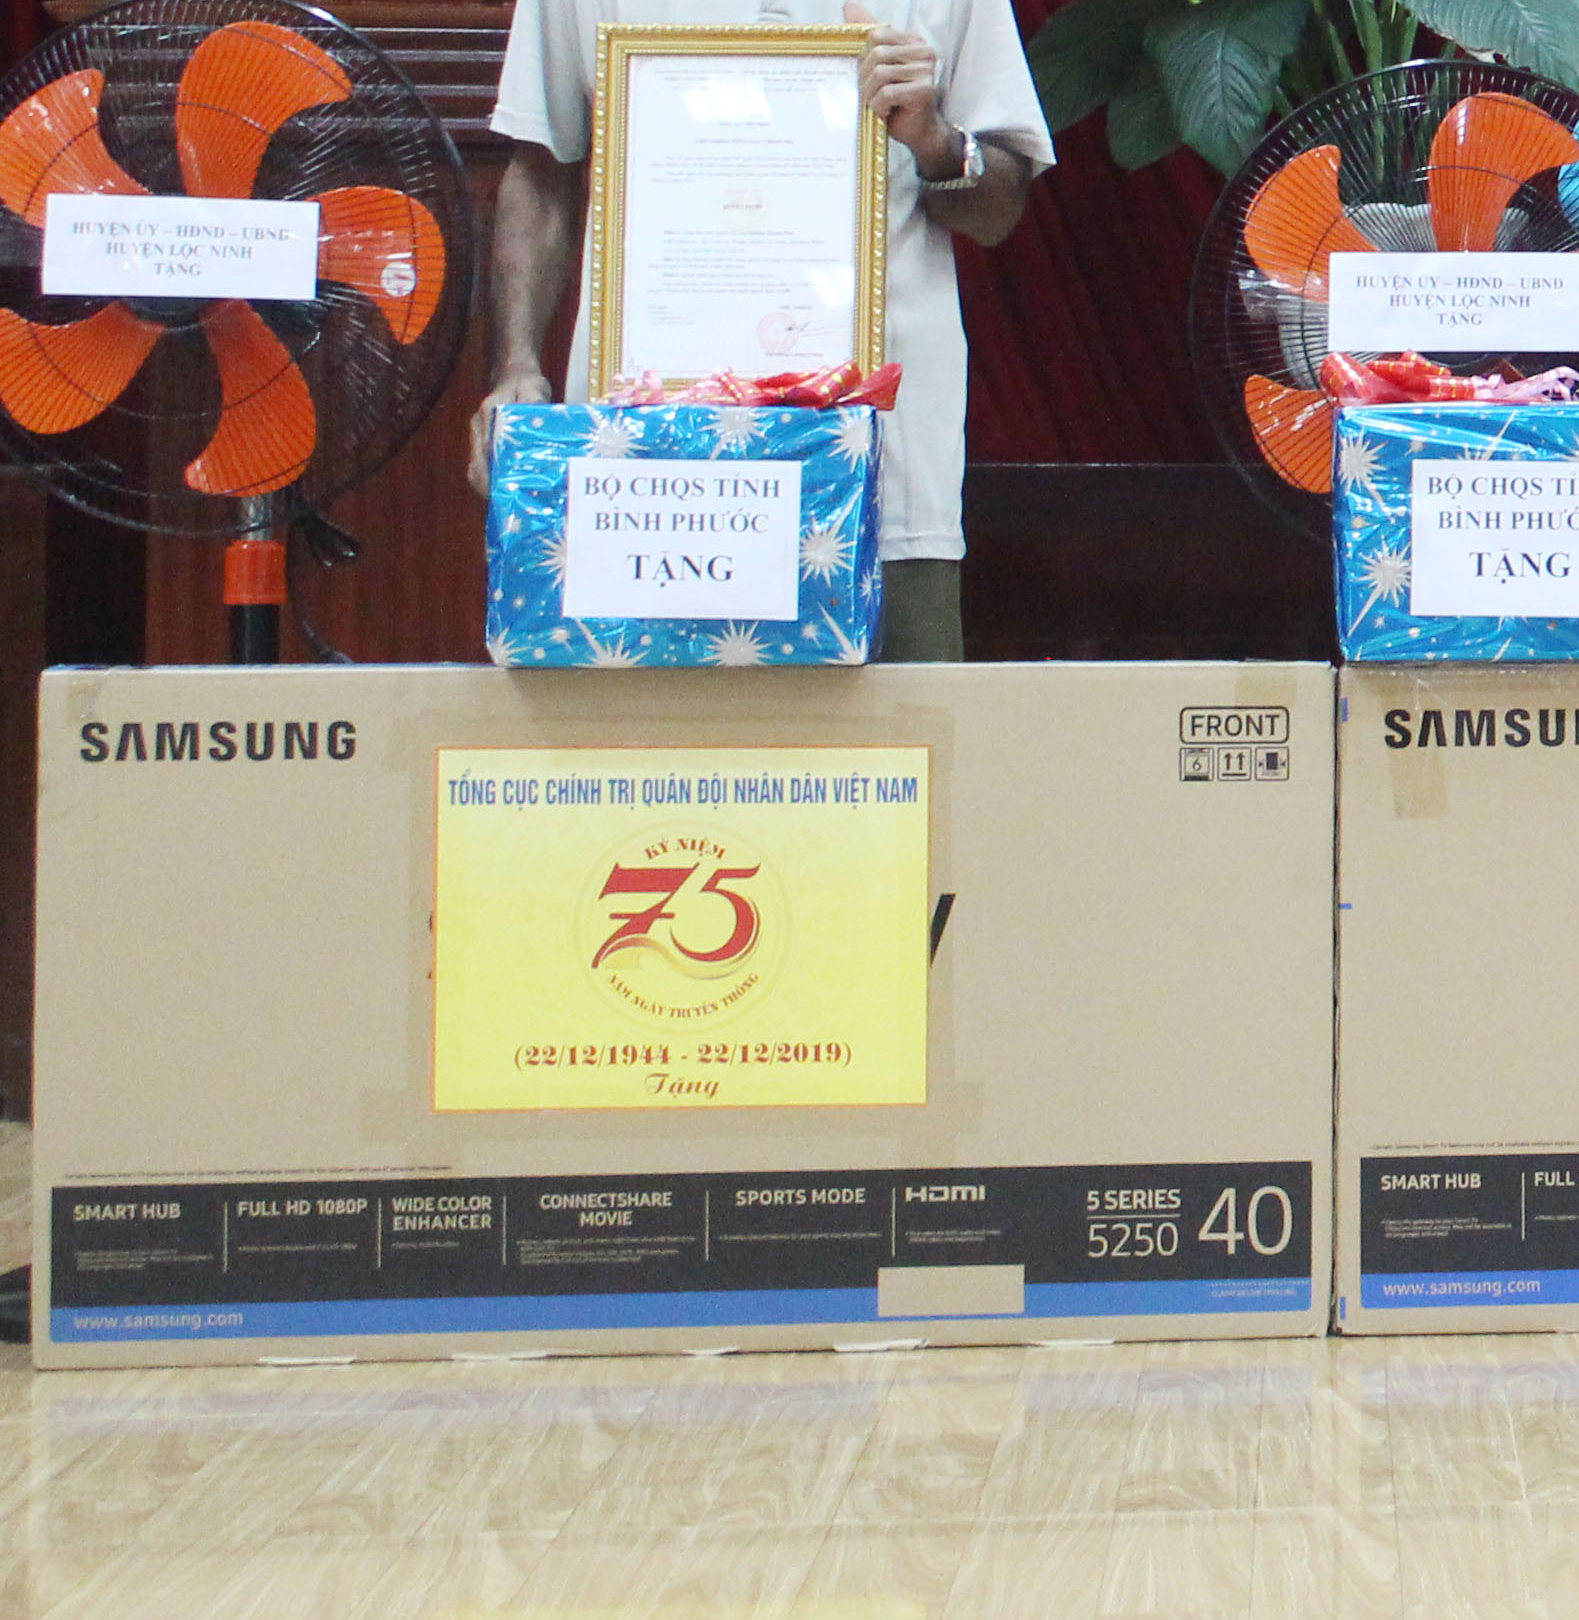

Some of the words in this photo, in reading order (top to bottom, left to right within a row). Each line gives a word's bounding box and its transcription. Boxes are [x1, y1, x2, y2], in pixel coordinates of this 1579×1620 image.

[584, 472, 621, 501] BỘ
[630, 476, 705, 501] CHQS
[1427, 473, 1463, 499] BỘ
[1471, 476, 1543, 501] CHQS
[671, 507, 769, 534] PHƯỚC
[627, 550, 735, 587] TẶNG
[1469, 548, 1572, 584] TẶNG
[79, 720, 357, 763] SAMSUNG
[1190, 714, 1280, 737] FRONT
[449, 768, 496, 805] TỔNG
[503, 779, 539, 811] CỤC
[546, 773, 601, 805] CHÍNH
[608, 779, 636, 810] TRỊ
[642, 773, 691, 806] QUÂN
[697, 773, 727, 810] ĐỘI
[734, 772, 784, 804] NHÂN
[790, 772, 825, 804] DÂN
[833, 772, 870, 810] VIỆT
[876, 777, 917, 803] NAM
[592, 862, 761, 968] 75
[1381, 1174, 1441, 1192] SMART
[1445, 1172, 1481, 1190] HUB
[1535, 1172, 1575, 1187] FULL
[1198, 1185, 1294, 1256] 40
[1088, 1221, 1178, 1258] 5250
[1384, 1277, 1540, 1299] www.samsung.com
